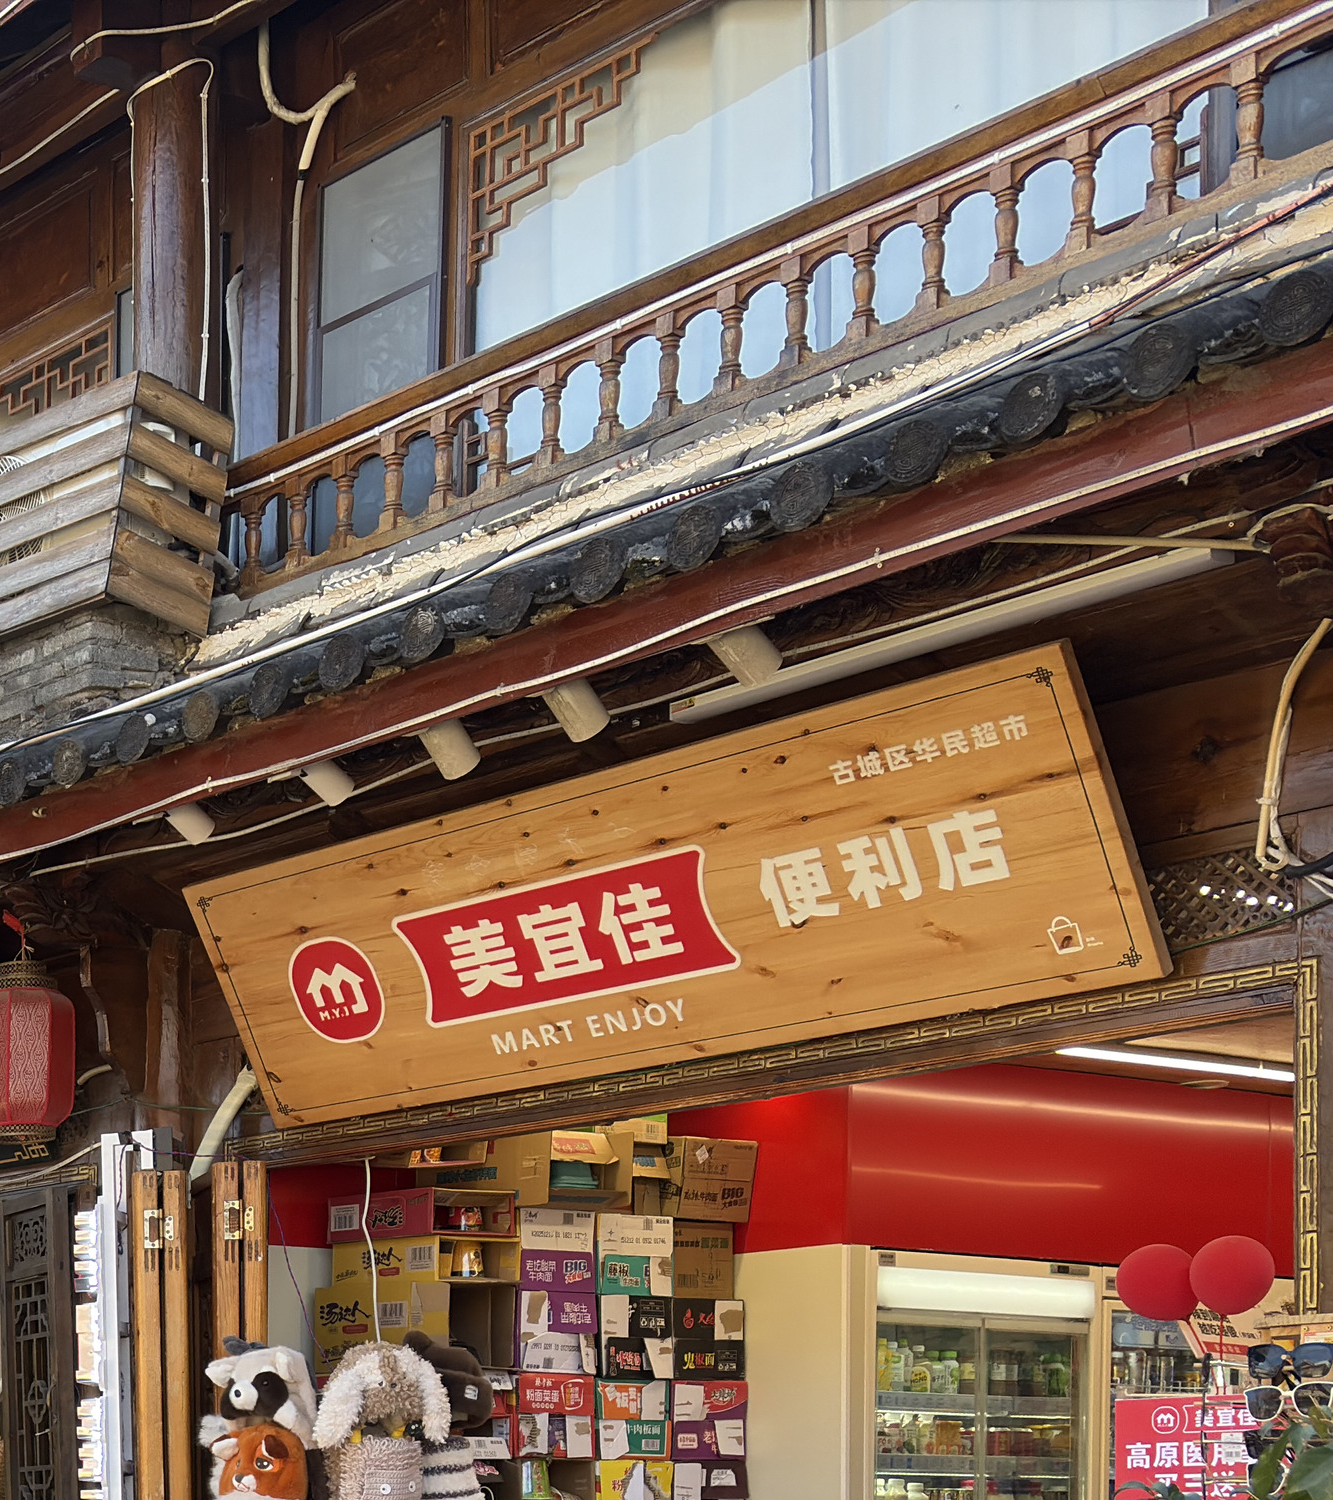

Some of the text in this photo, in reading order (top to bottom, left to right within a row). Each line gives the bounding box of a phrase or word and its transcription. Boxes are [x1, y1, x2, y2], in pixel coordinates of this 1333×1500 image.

[829, 714, 1029, 785] 古城区华民超市
[759, 809, 1010, 928] 便利店
[443, 882, 684, 998] 美宜佳
[491, 998, 686, 1055] MART ENJOY
[528, 1271, 553, 1283] 牛肉面
[563, 1260, 588, 1273] BIG
